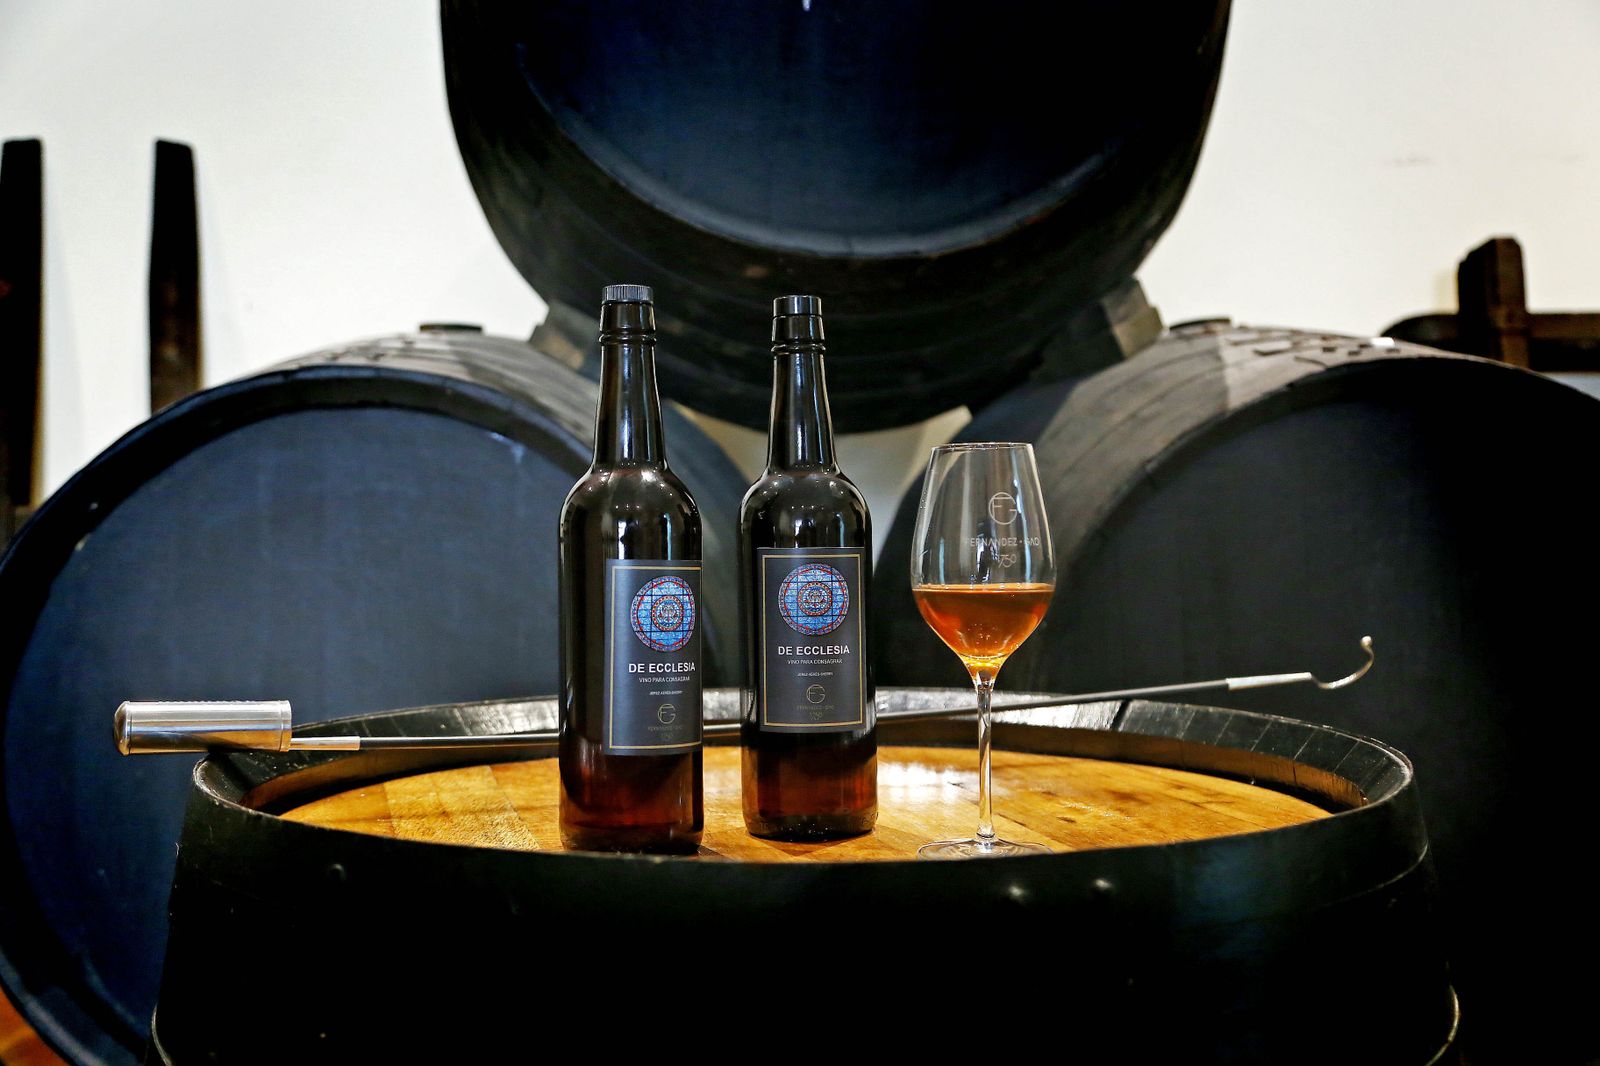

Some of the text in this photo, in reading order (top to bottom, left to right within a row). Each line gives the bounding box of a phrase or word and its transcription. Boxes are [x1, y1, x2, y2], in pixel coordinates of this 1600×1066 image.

[778, 645, 850, 655] DE ECCLESIA
[628, 661, 696, 673] DE ECCLESIA
